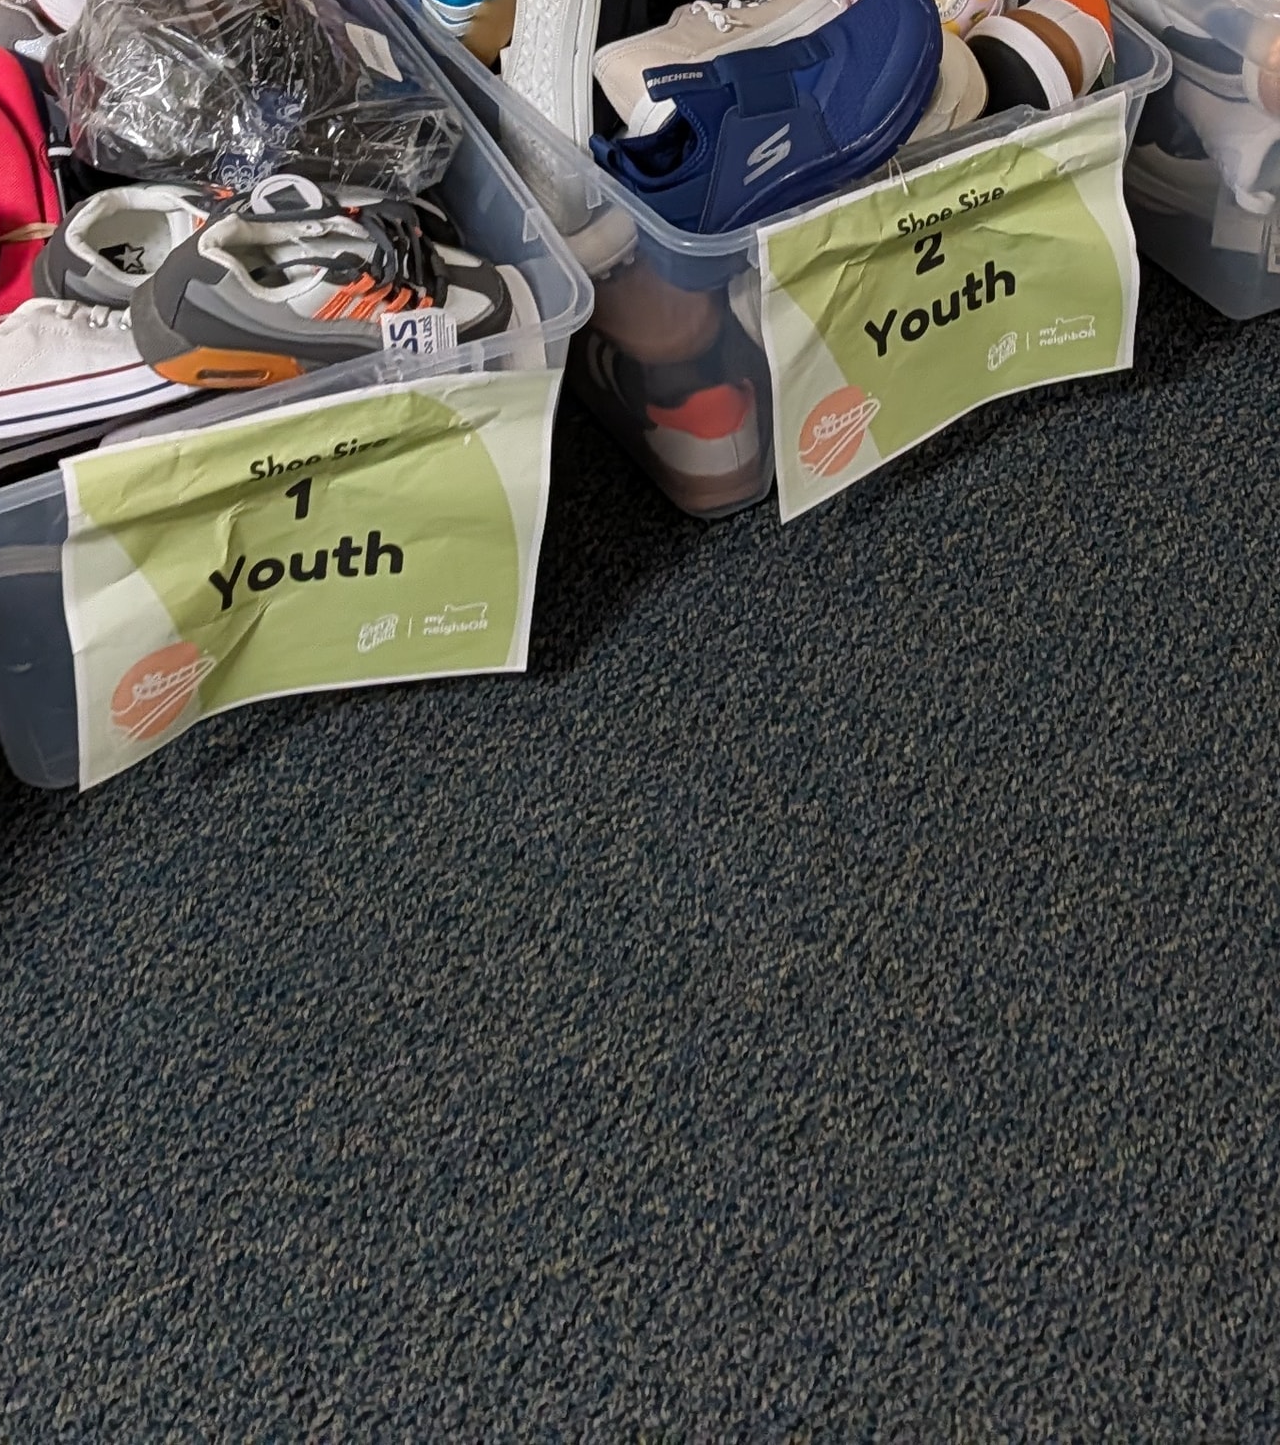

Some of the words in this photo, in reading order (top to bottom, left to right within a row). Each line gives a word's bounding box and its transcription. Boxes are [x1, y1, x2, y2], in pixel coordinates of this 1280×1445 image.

[647, 72, 703, 89] SKECHERS
[897, 213, 953, 238] Shoe
[959, 187, 1005, 214] Size
[914, 231, 945, 276] 2
[864, 260, 1016, 357] Youth
[285, 477, 313, 521] 1
[209, 530, 403, 612] Youth
